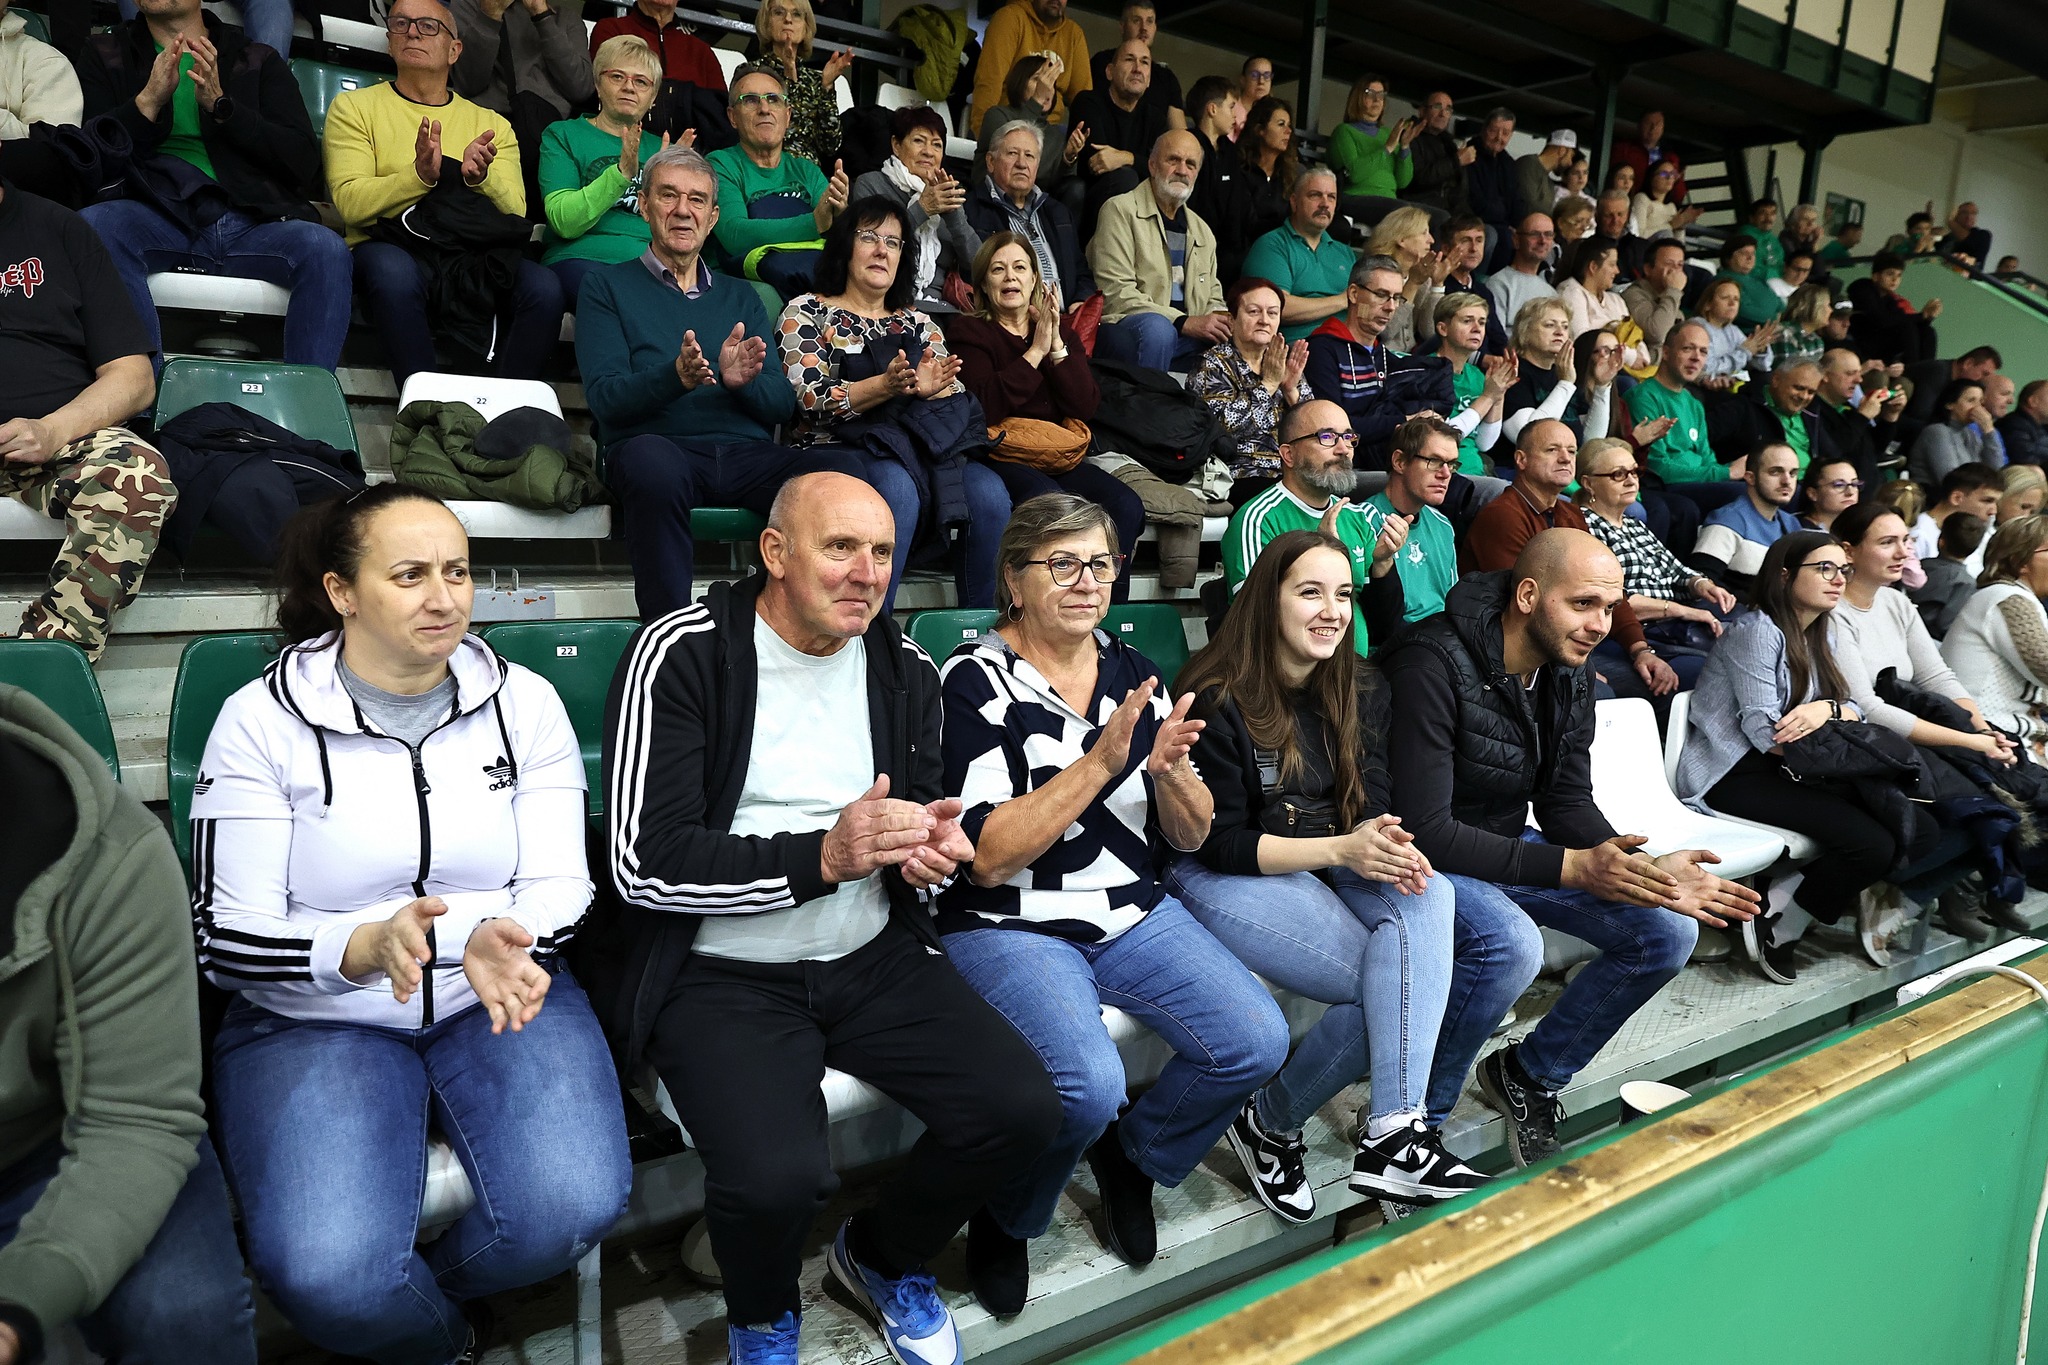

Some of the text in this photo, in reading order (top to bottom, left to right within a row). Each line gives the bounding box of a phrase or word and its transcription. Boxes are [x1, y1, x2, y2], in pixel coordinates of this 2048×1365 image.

[476, 397, 487, 405] 22
[561, 647, 574, 655] 22
[489, 777, 516, 791] adid
